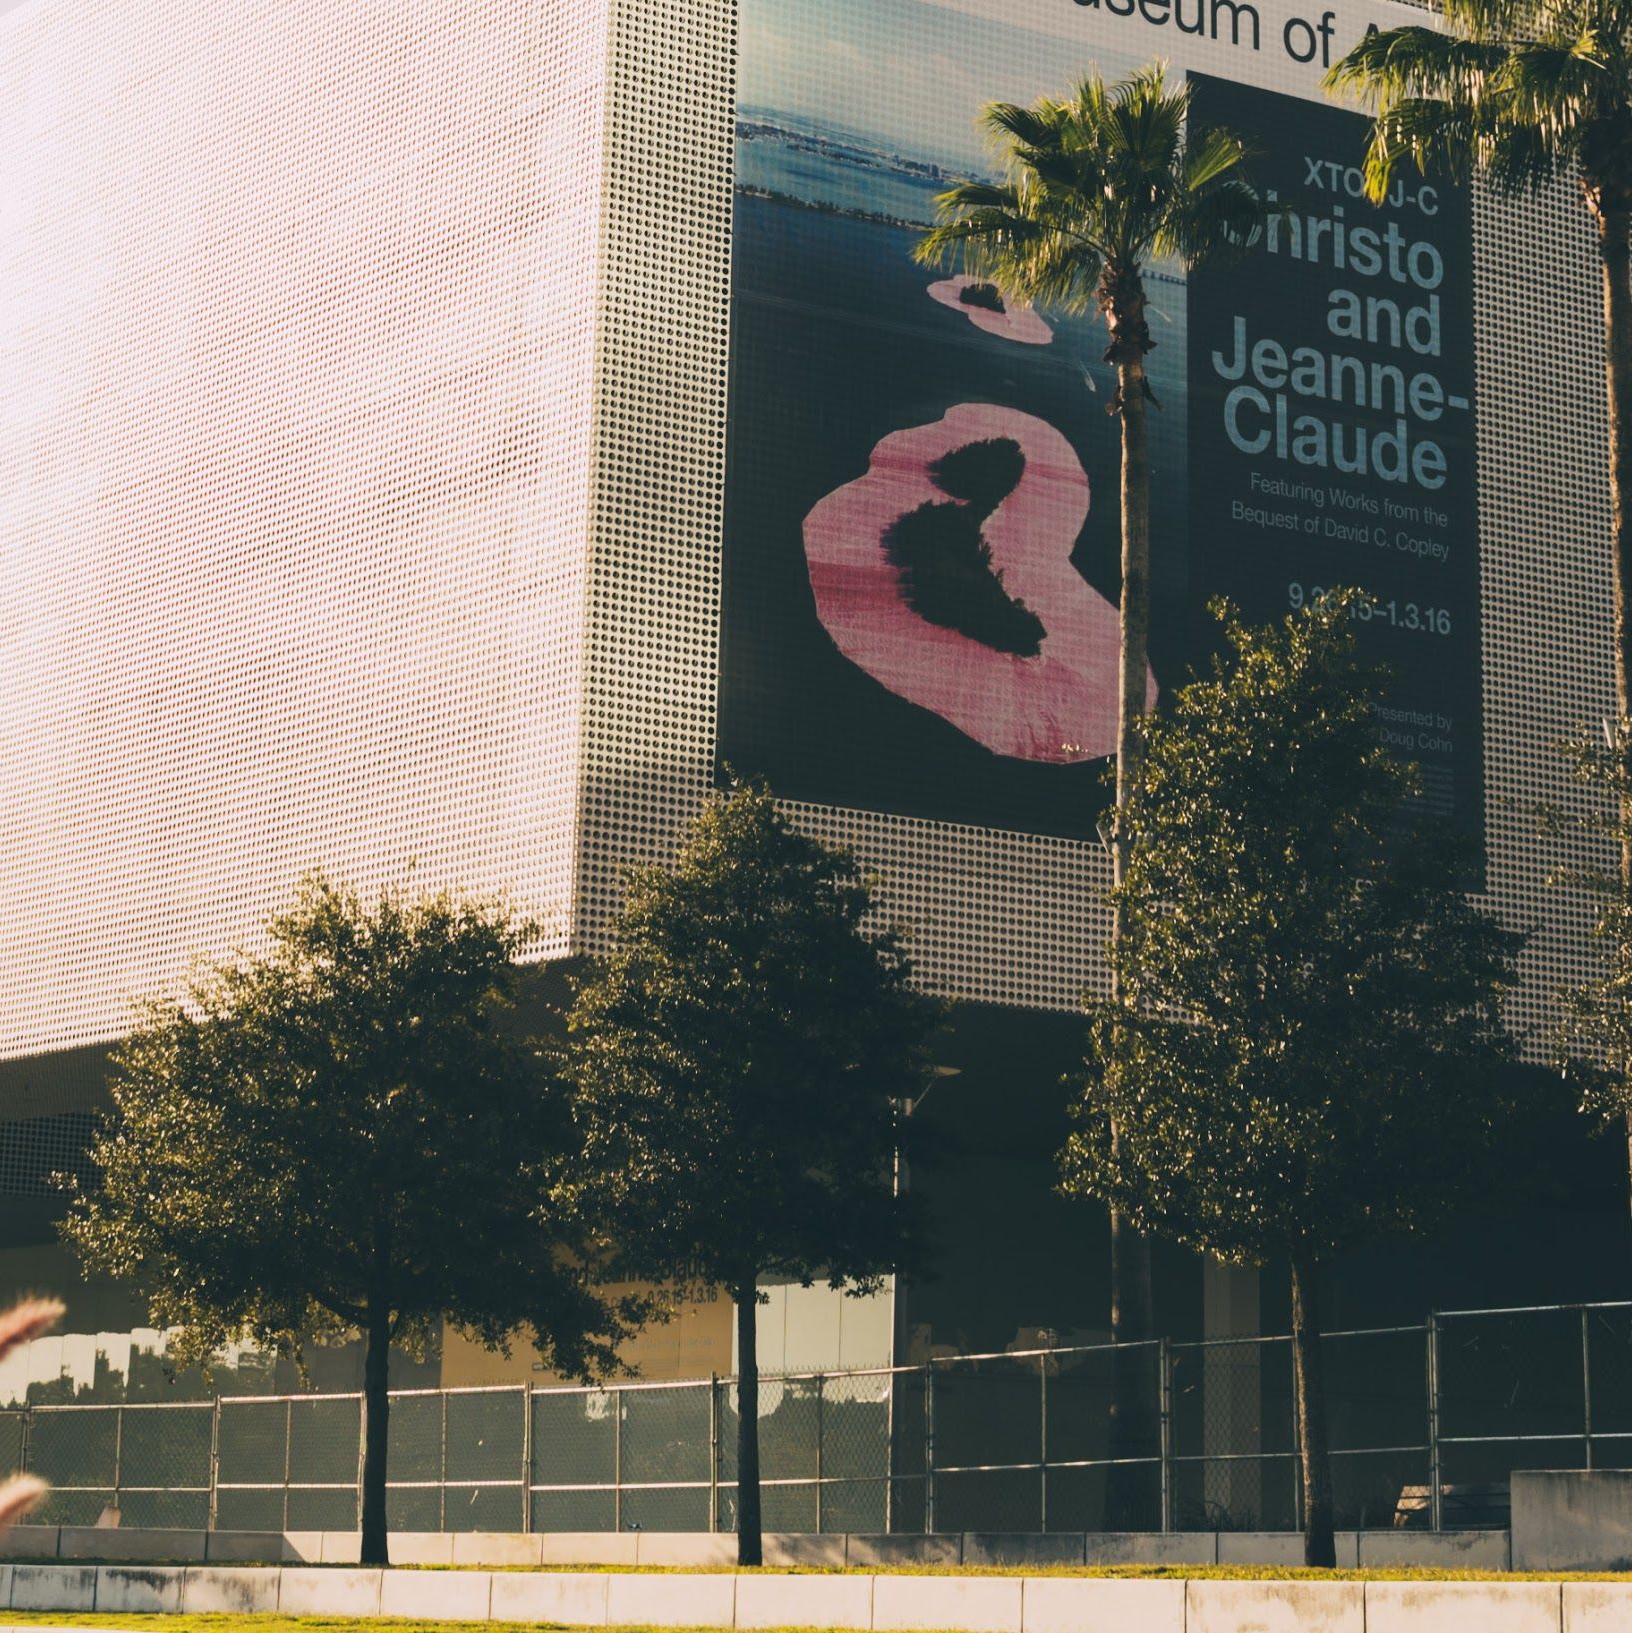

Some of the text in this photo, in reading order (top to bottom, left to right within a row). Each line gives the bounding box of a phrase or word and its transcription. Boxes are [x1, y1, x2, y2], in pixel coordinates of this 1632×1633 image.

[1283, 11, 1335, 68] of
[1304, 156, 1439, 216] XTO J-C
[1327, 288, 1440, 357] and
[1212, 316, 1469, 421] Jeanne-
[1223, 385, 1447, 490] Claude
[1250, 472, 1448, 528] Featuring Works from the
[1232, 500, 1449, 562] Bequest of David C. Copley
[1367, 701, 1453, 733] Presented by
[1379, 727, 1414, 750] Doug
[1418, 733, 1453, 753] Cohn
